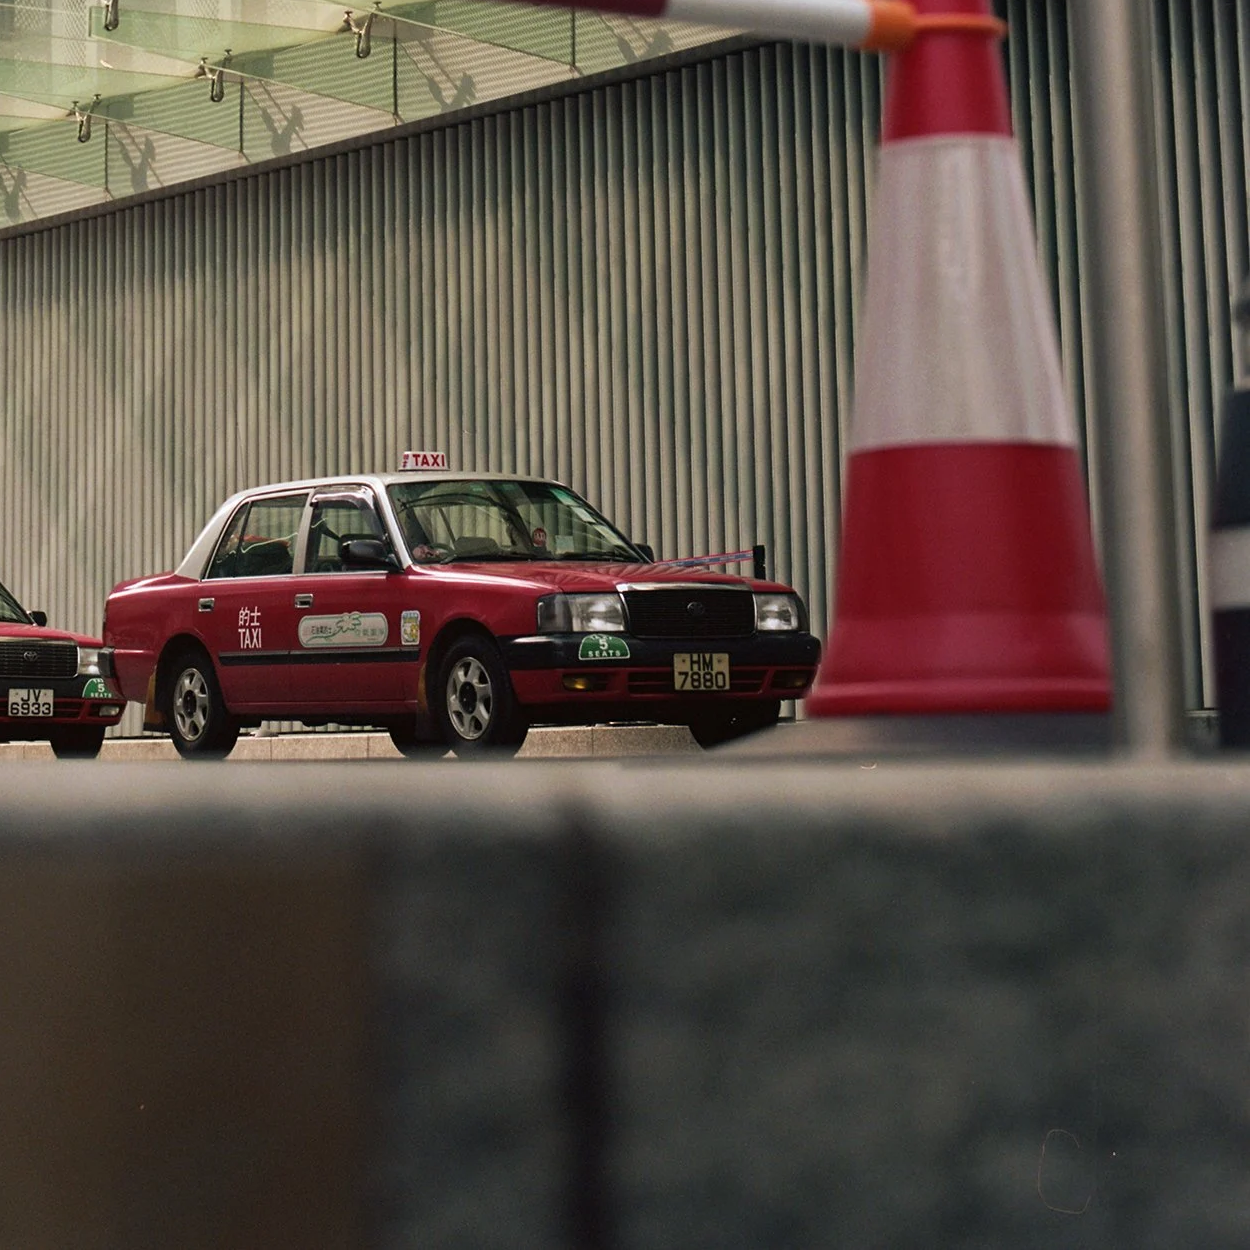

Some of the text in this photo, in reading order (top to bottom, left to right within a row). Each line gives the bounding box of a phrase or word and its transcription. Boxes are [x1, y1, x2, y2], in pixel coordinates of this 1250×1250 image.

[412, 453, 445, 467] TAXI
[238, 606, 261, 626] 的士
[238, 628, 262, 648] TAXI
[599, 639, 608, 649] 5
[588, 650, 621, 658] SEATS
[690, 653, 714, 671] HM
[97, 683, 105, 692] 5
[678, 671, 726, 690] 7880
[21, 689, 42, 702] JV
[10, 702, 52, 716] 6933
